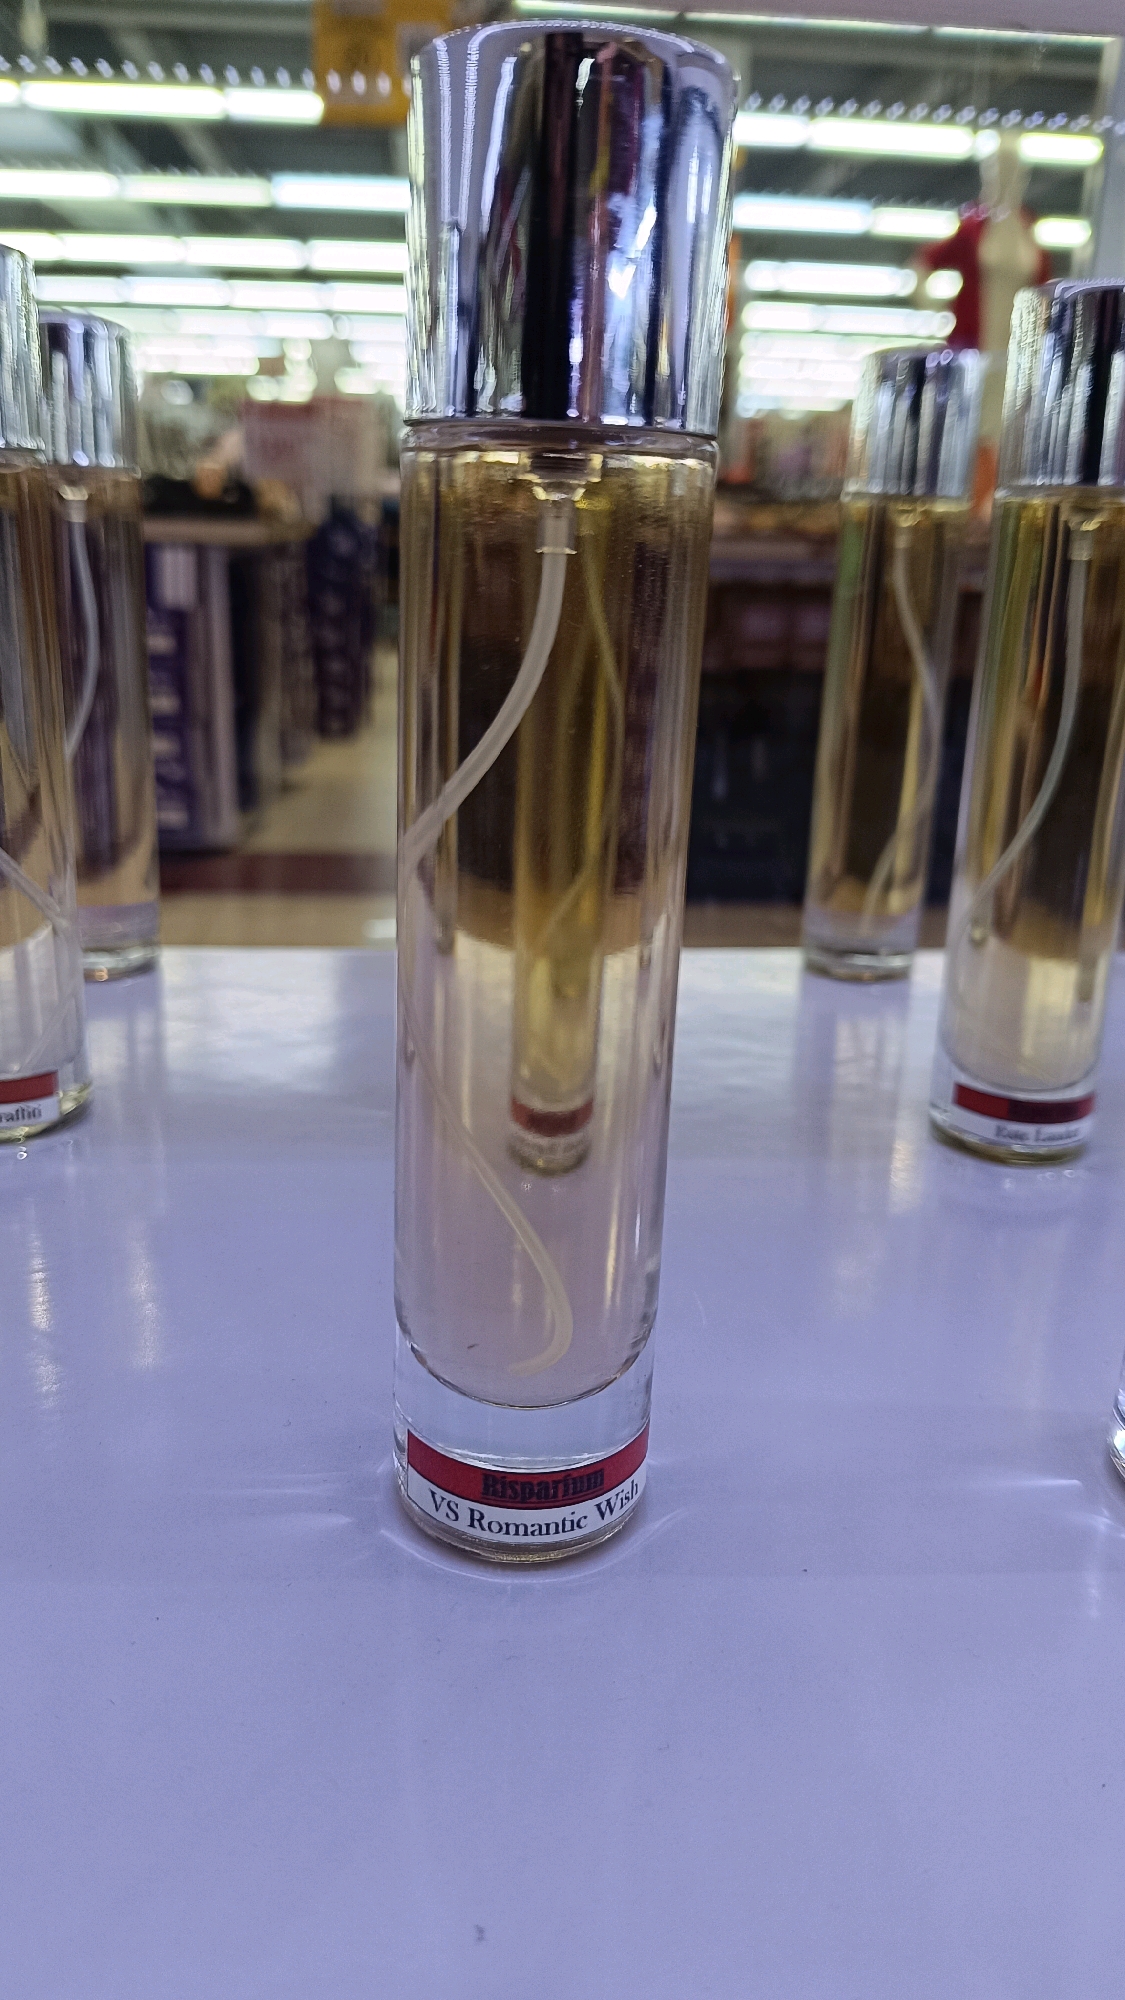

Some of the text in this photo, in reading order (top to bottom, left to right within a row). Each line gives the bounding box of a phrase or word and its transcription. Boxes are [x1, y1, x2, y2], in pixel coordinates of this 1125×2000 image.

[428, 1479, 640, 1537] VS Romantic Wish
